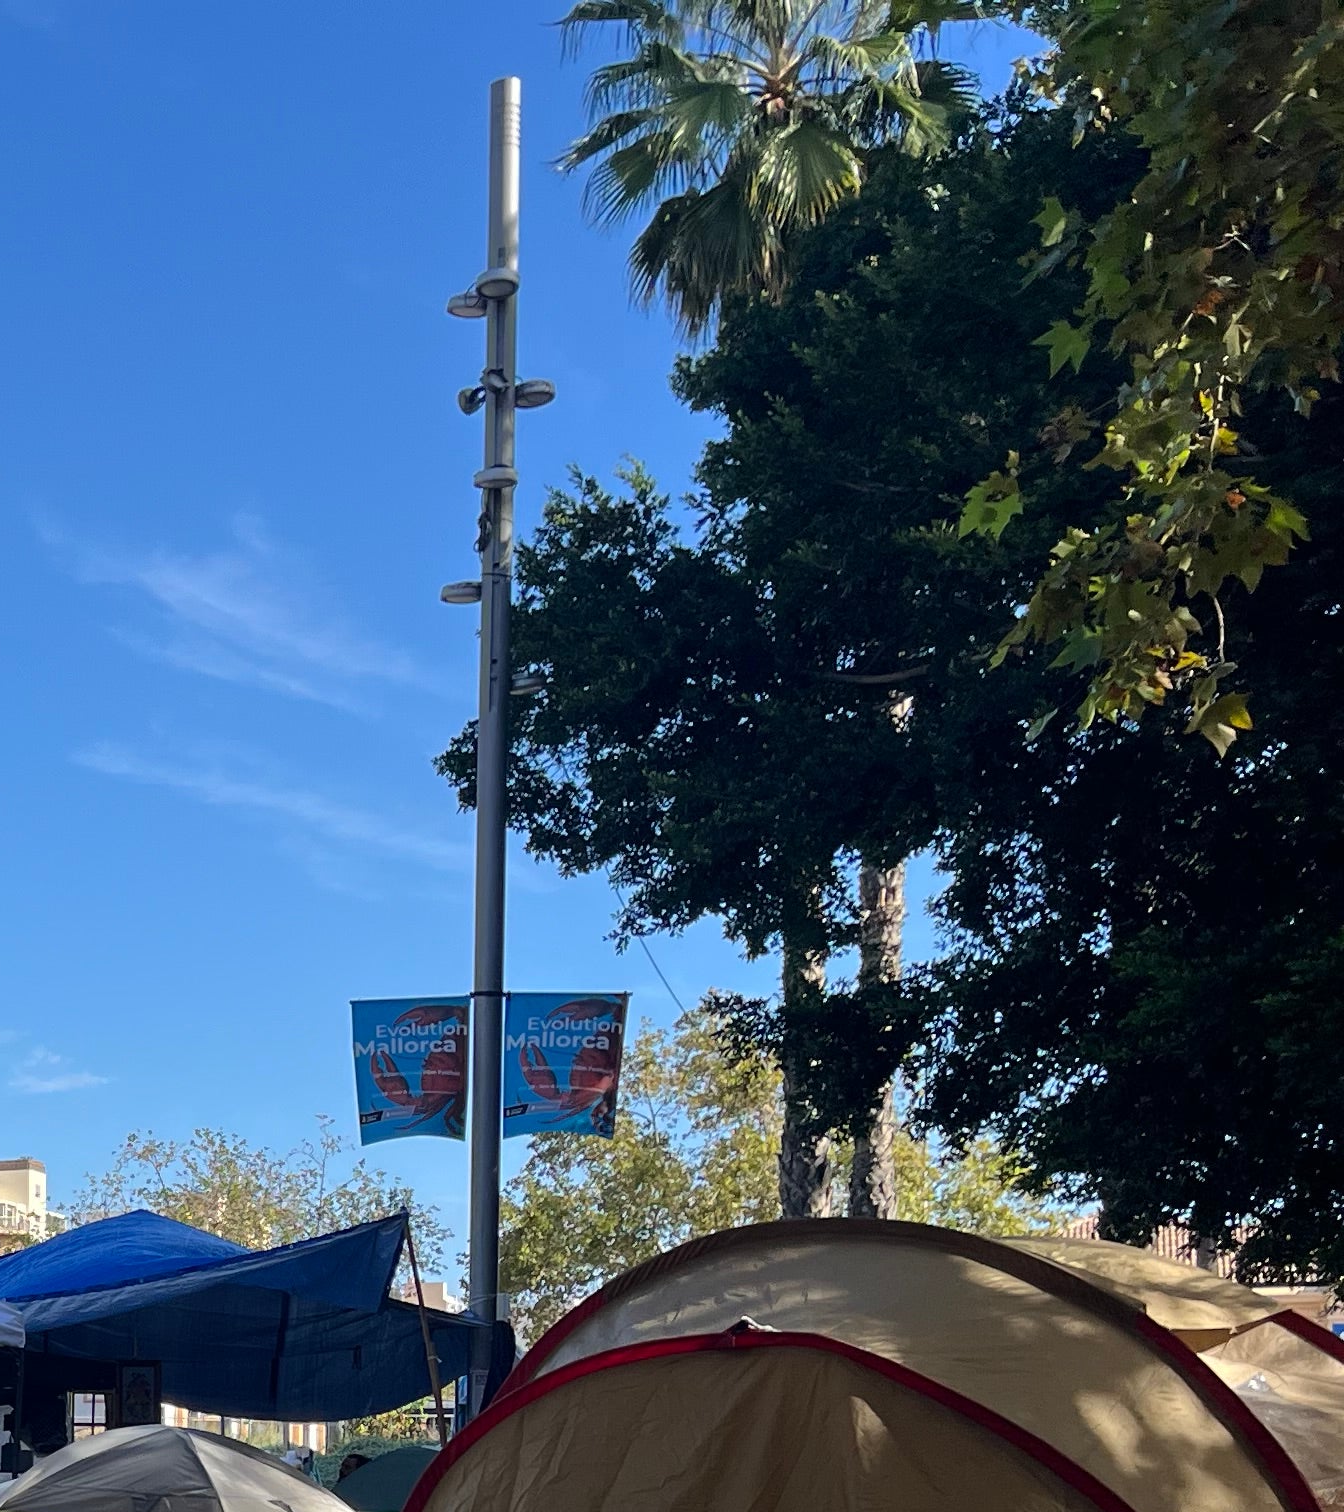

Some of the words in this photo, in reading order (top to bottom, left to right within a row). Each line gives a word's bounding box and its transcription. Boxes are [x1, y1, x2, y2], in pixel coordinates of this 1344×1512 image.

[375, 1020, 468, 1039] Evolution
[527, 1016, 623, 1034] Evolution
[355, 1036, 457, 1057] Mallorca
[506, 1031, 610, 1051] Mallorca
